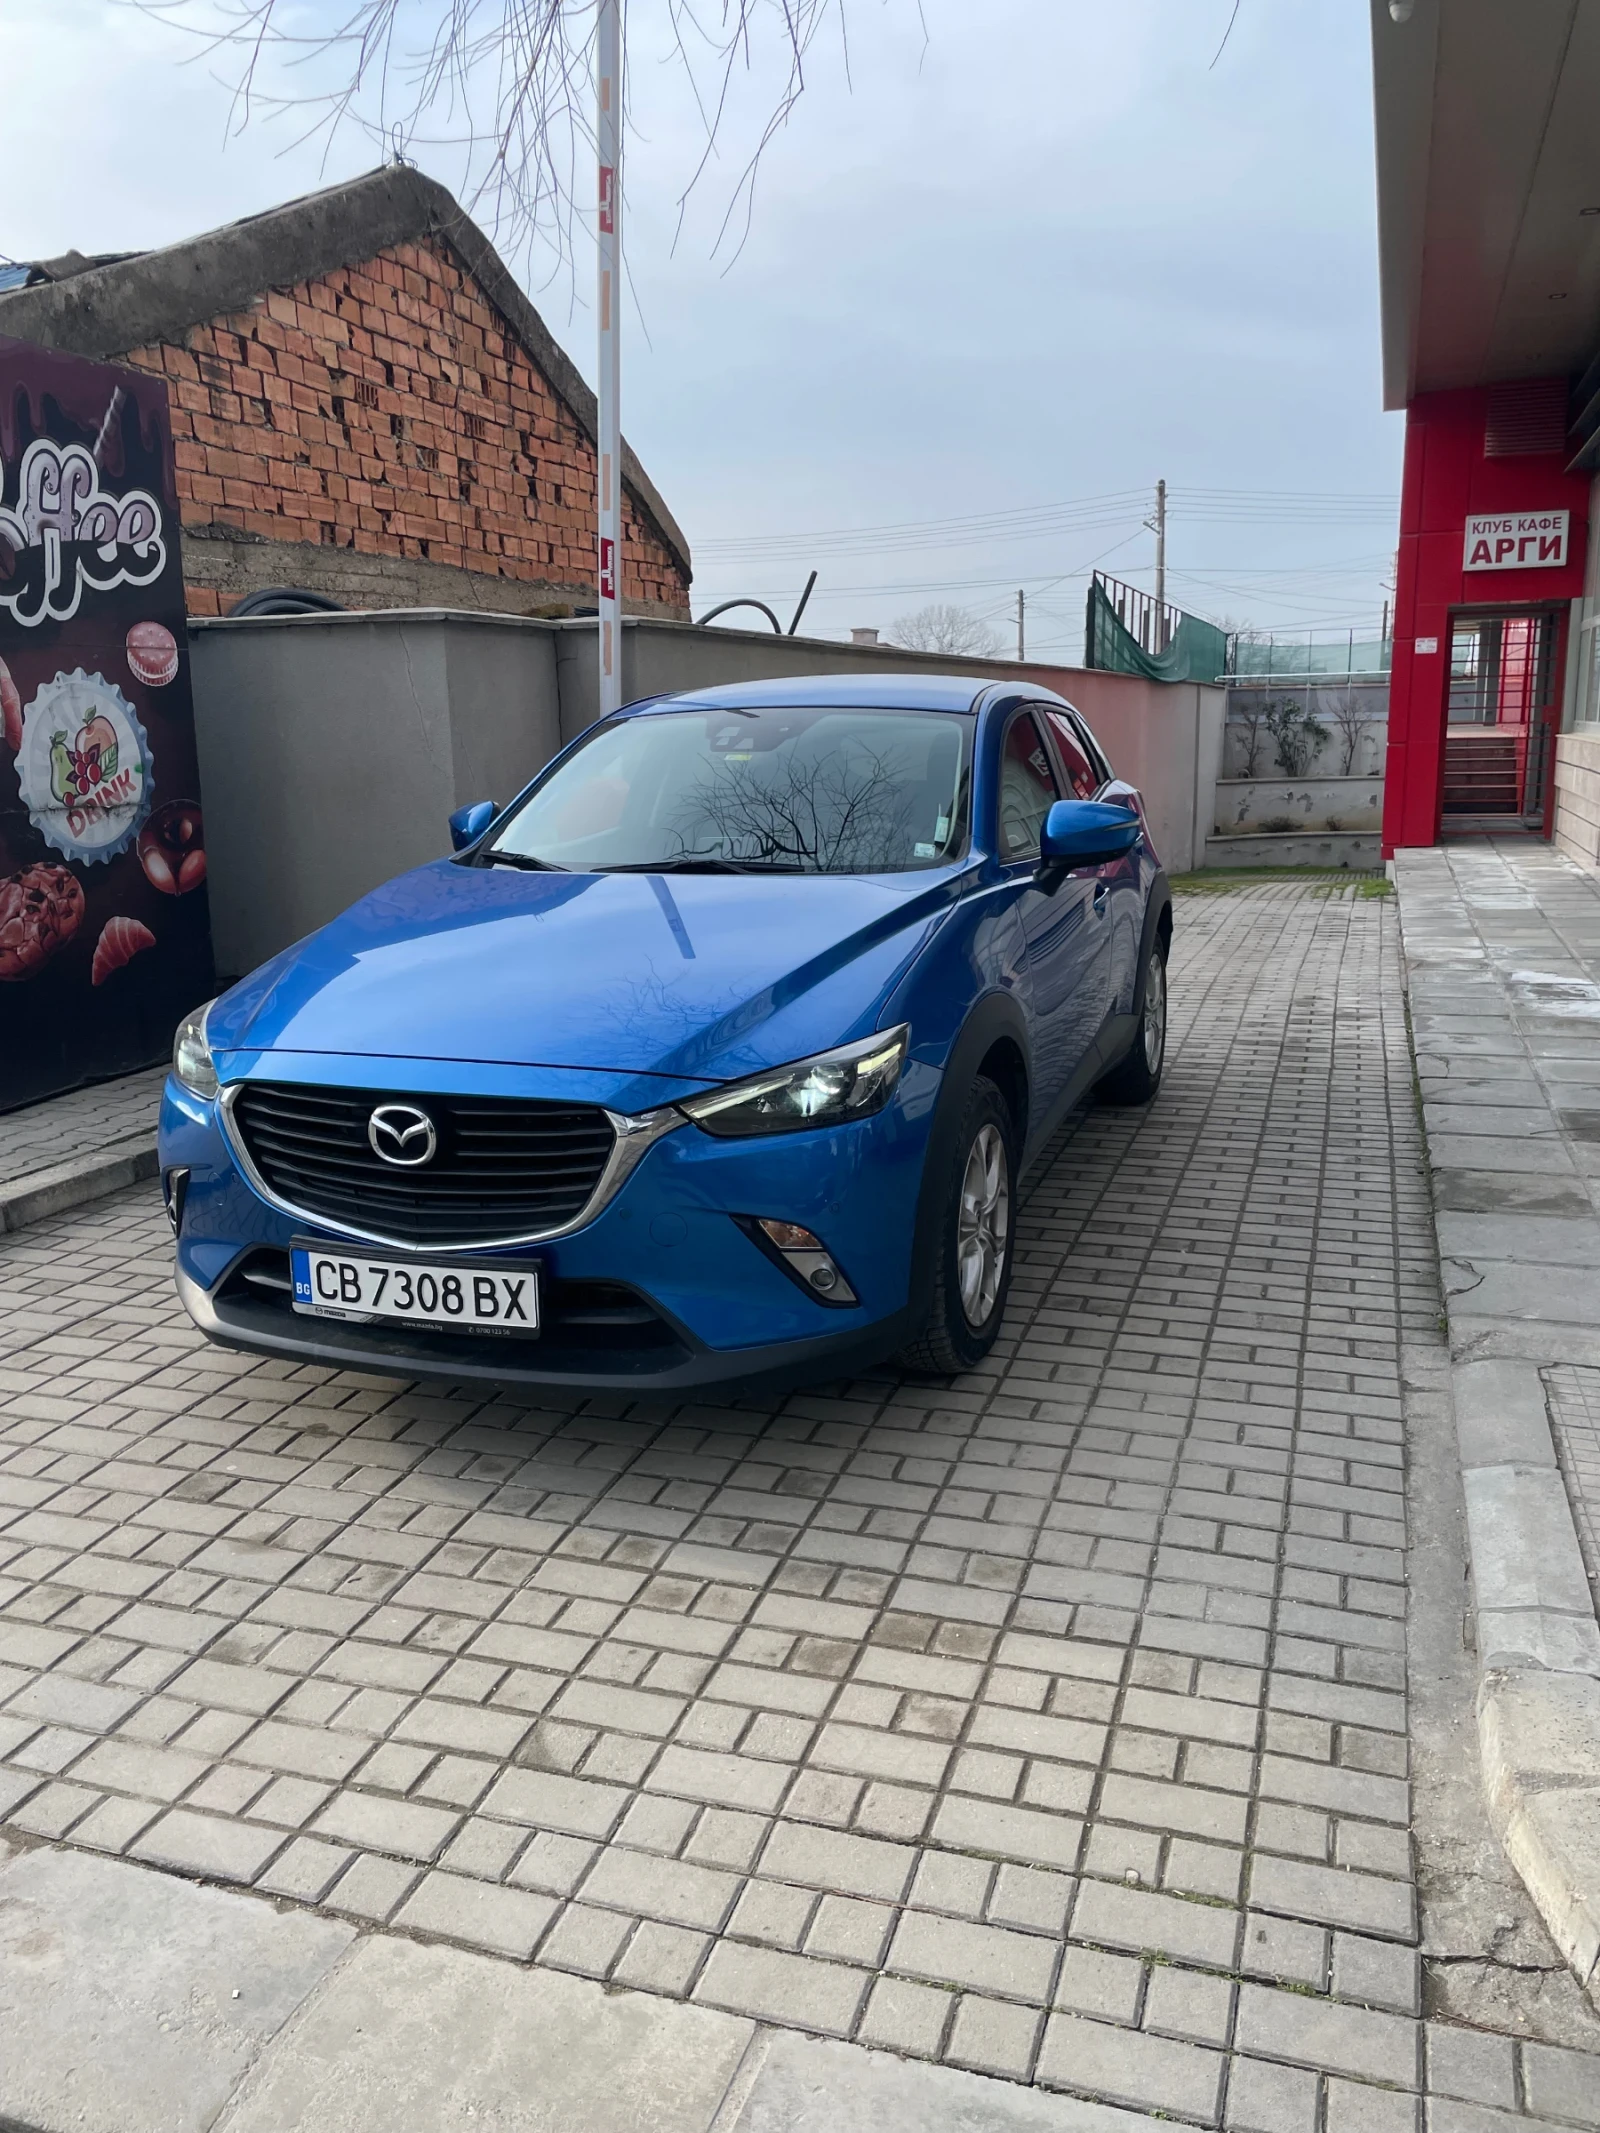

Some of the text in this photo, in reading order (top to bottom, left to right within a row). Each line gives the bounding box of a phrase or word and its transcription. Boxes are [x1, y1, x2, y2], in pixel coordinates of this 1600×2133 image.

[1472, 517, 1562, 534] КЛУБ КАФЕ
[1469, 536, 1561, 564] АРГИ
[66, 767, 137, 838] DRINK
[296, 1282, 311, 1296] BG
